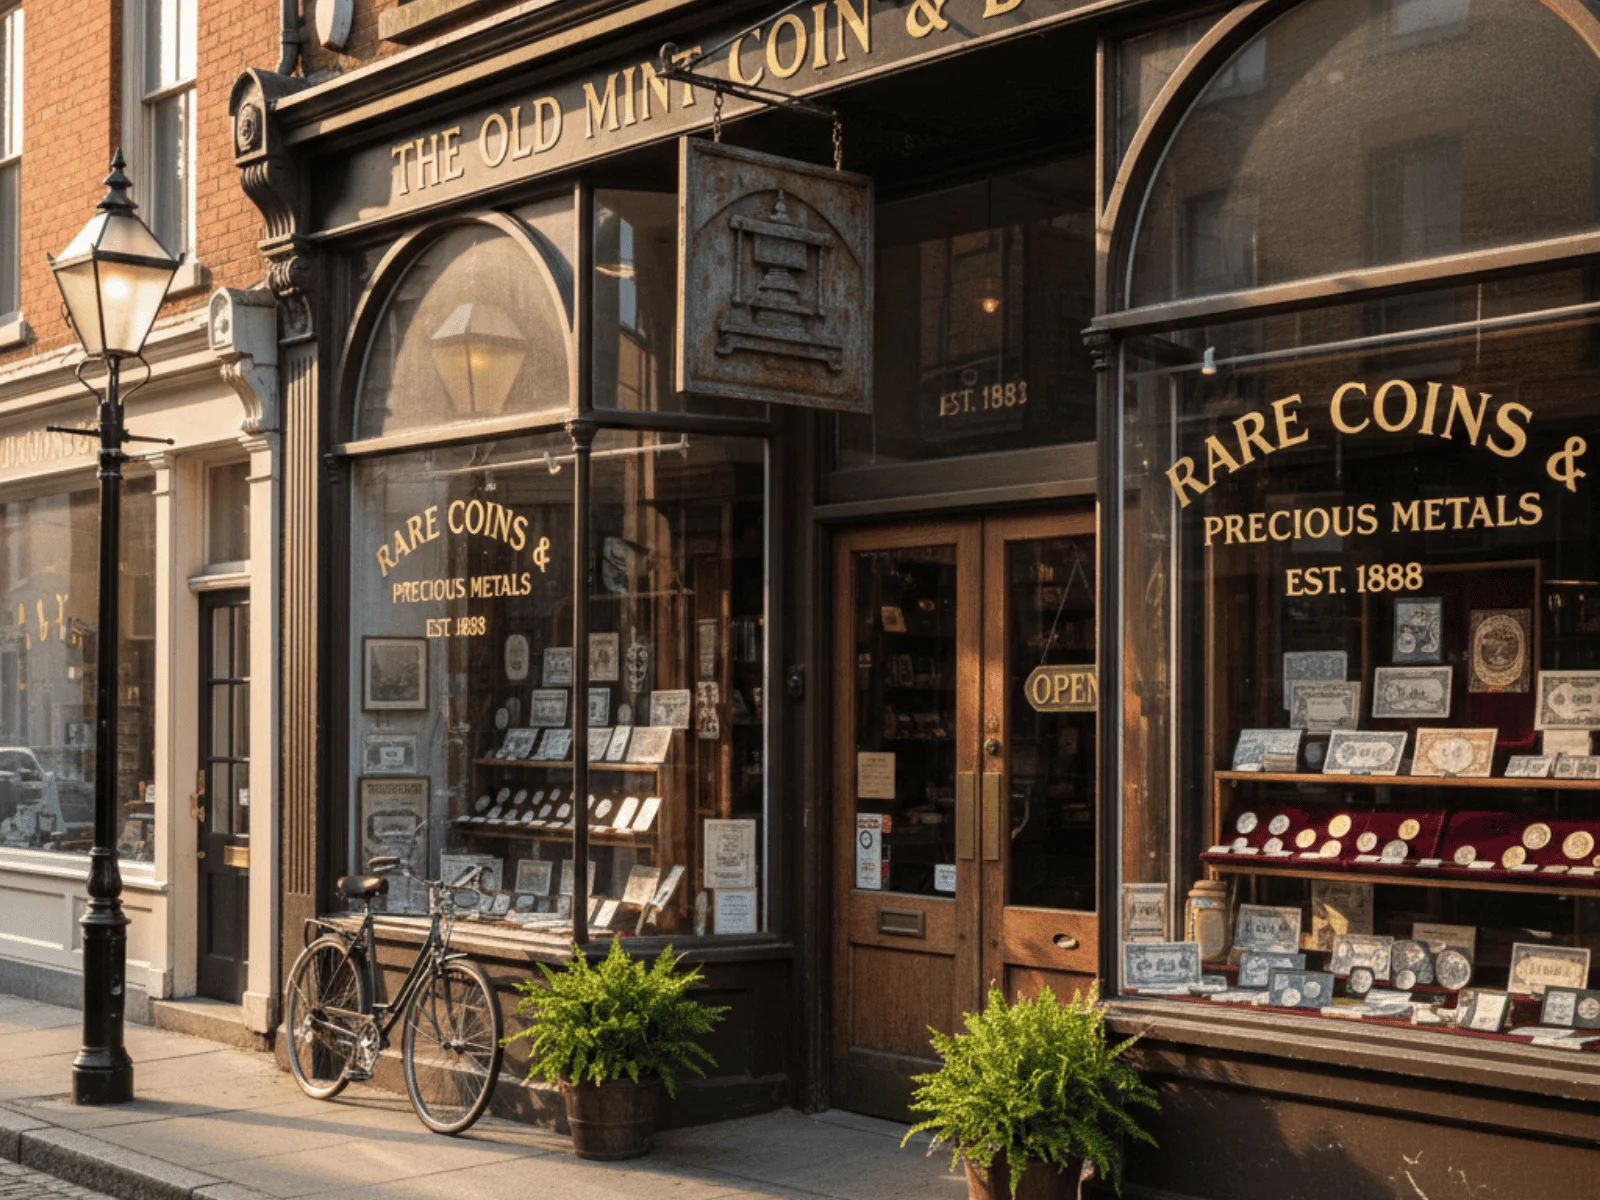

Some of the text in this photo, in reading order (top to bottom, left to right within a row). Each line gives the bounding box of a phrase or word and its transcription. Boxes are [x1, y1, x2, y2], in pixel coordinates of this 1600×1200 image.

[391, 0, 949, 196] THE OLD MINT COIN &
[1165, 379, 1588, 509] RARE COINS &
[375, 499, 551, 577] RARE COINS &
[1203, 492, 1544, 547] PRECIOUS METALS
[393, 572, 532, 604] PRECIOUS METALS
[1285, 561, 1424, 597] EST. 1888
[1032, 672, 1099, 705] OPEN
